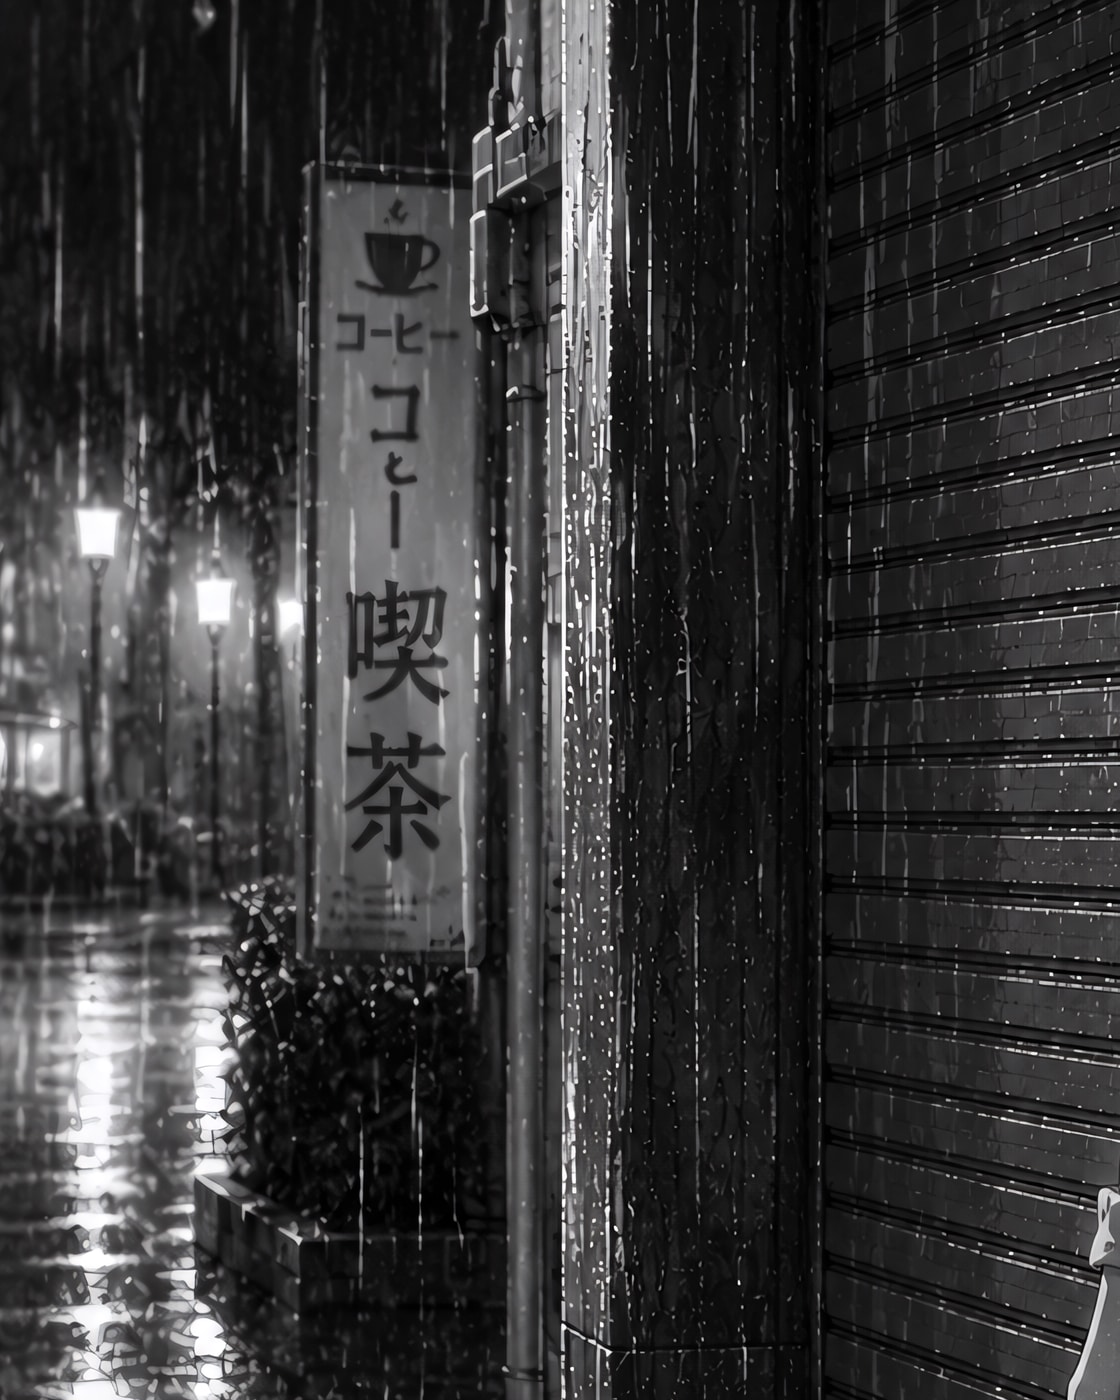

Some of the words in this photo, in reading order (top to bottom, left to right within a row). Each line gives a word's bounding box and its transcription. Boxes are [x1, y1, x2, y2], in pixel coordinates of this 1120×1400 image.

[336, 313, 460, 354] コーヒー
[344, 579, 451, 861] 喫茶
